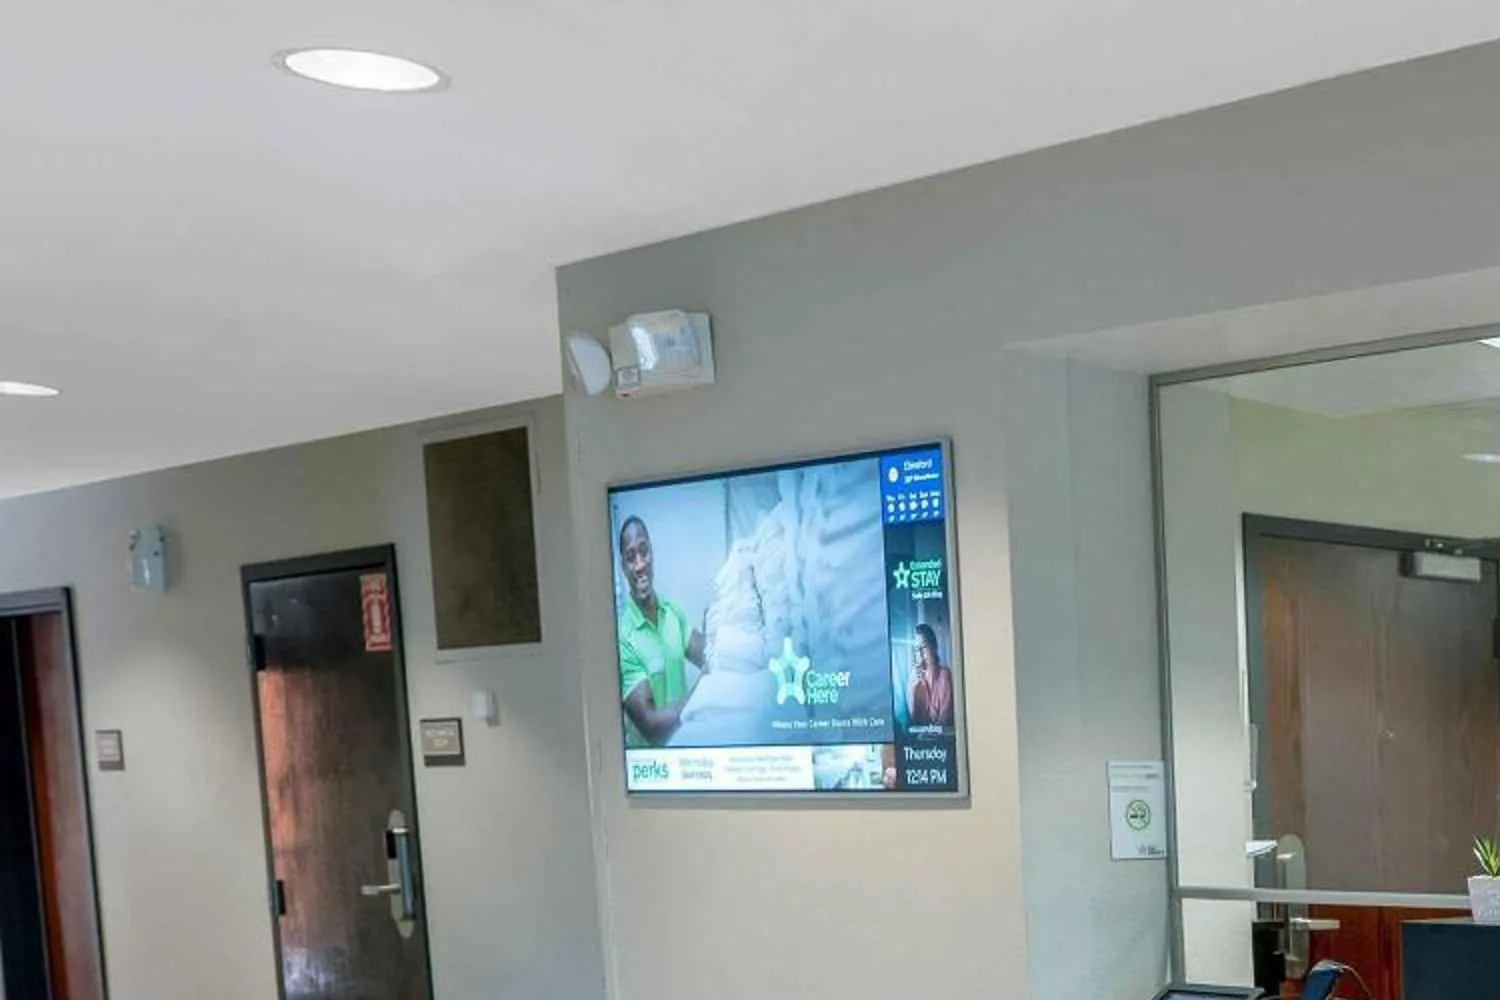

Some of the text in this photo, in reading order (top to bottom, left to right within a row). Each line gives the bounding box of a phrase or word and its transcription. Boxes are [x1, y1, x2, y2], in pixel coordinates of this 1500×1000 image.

[911, 570, 941, 588] STAY
[806, 670, 851, 688] Career
[806, 688, 839, 705] Here
[904, 746, 948, 763] Thursday
[632, 761, 668, 780] perks
[929, 768, 948, 785] PM
